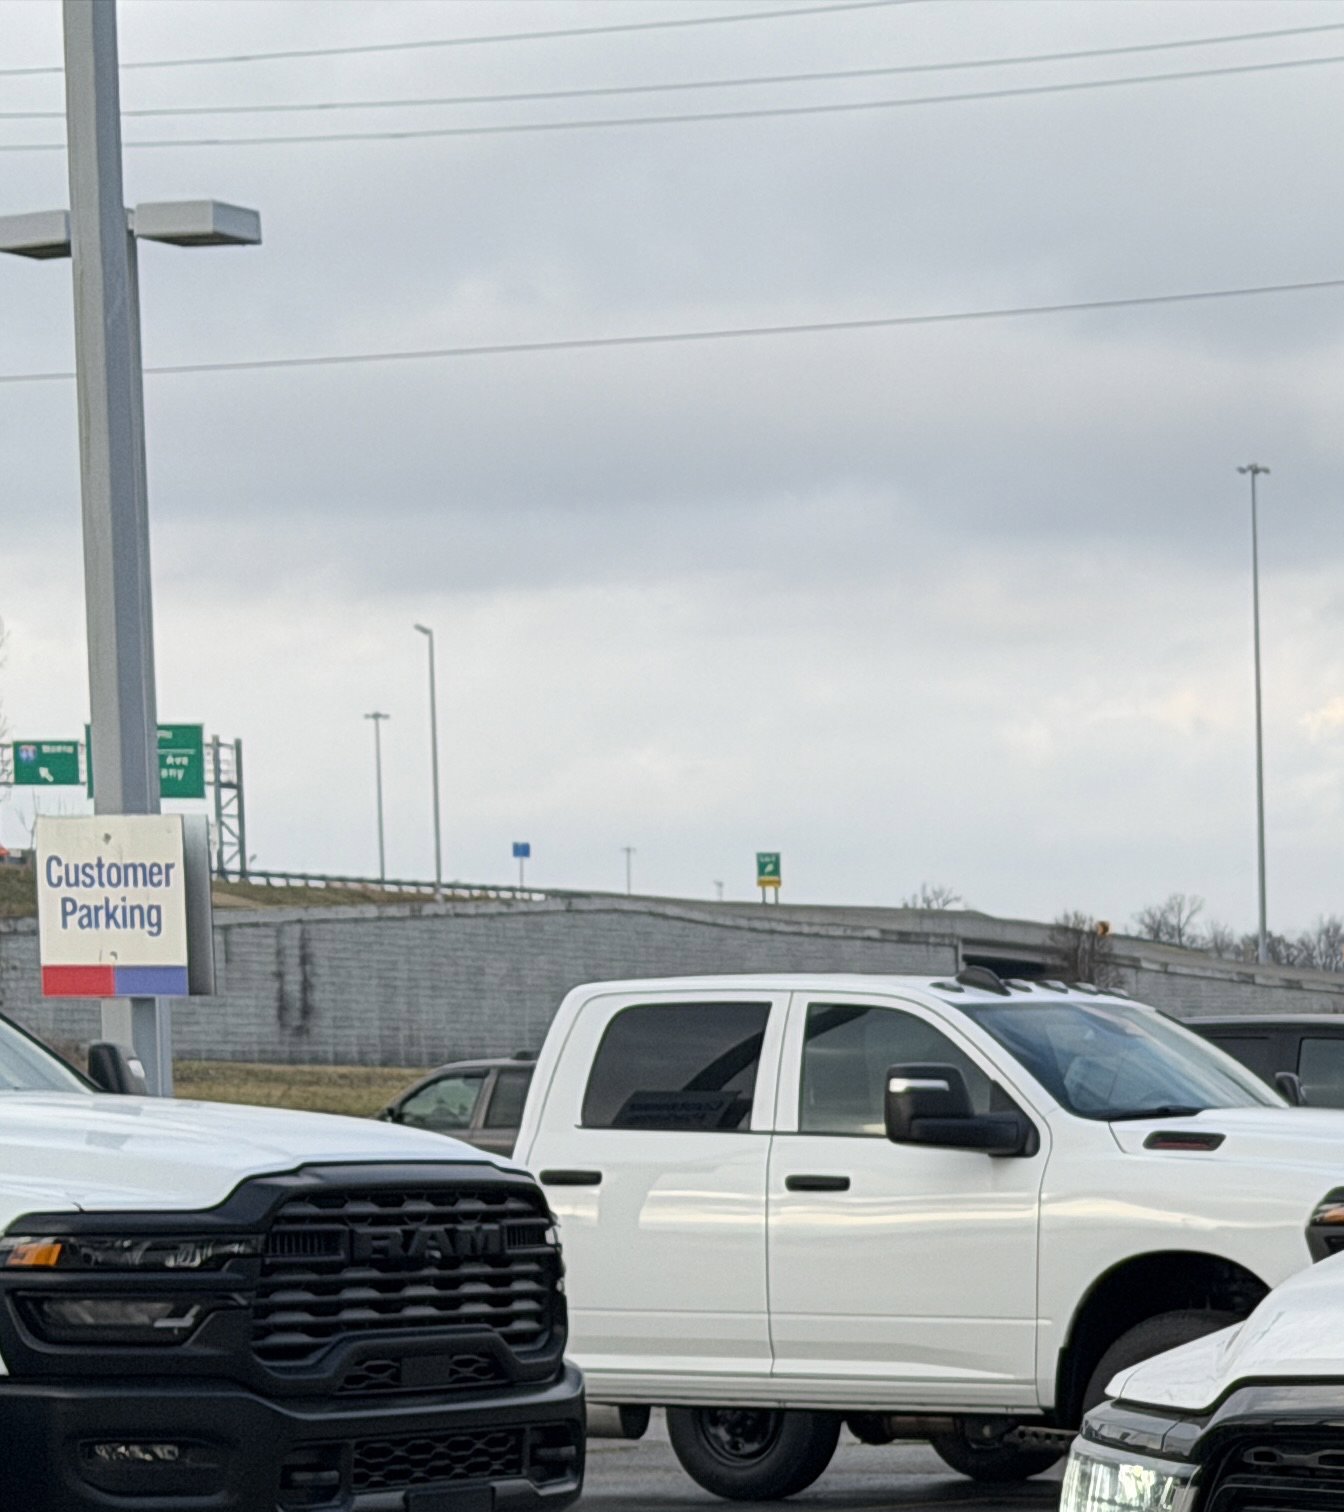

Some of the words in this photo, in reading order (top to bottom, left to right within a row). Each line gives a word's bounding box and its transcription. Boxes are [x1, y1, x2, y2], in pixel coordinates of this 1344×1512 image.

[45, 855, 176, 889] Customer
[60, 896, 162, 937] Parking
[350, 1223, 501, 1260] RAM
